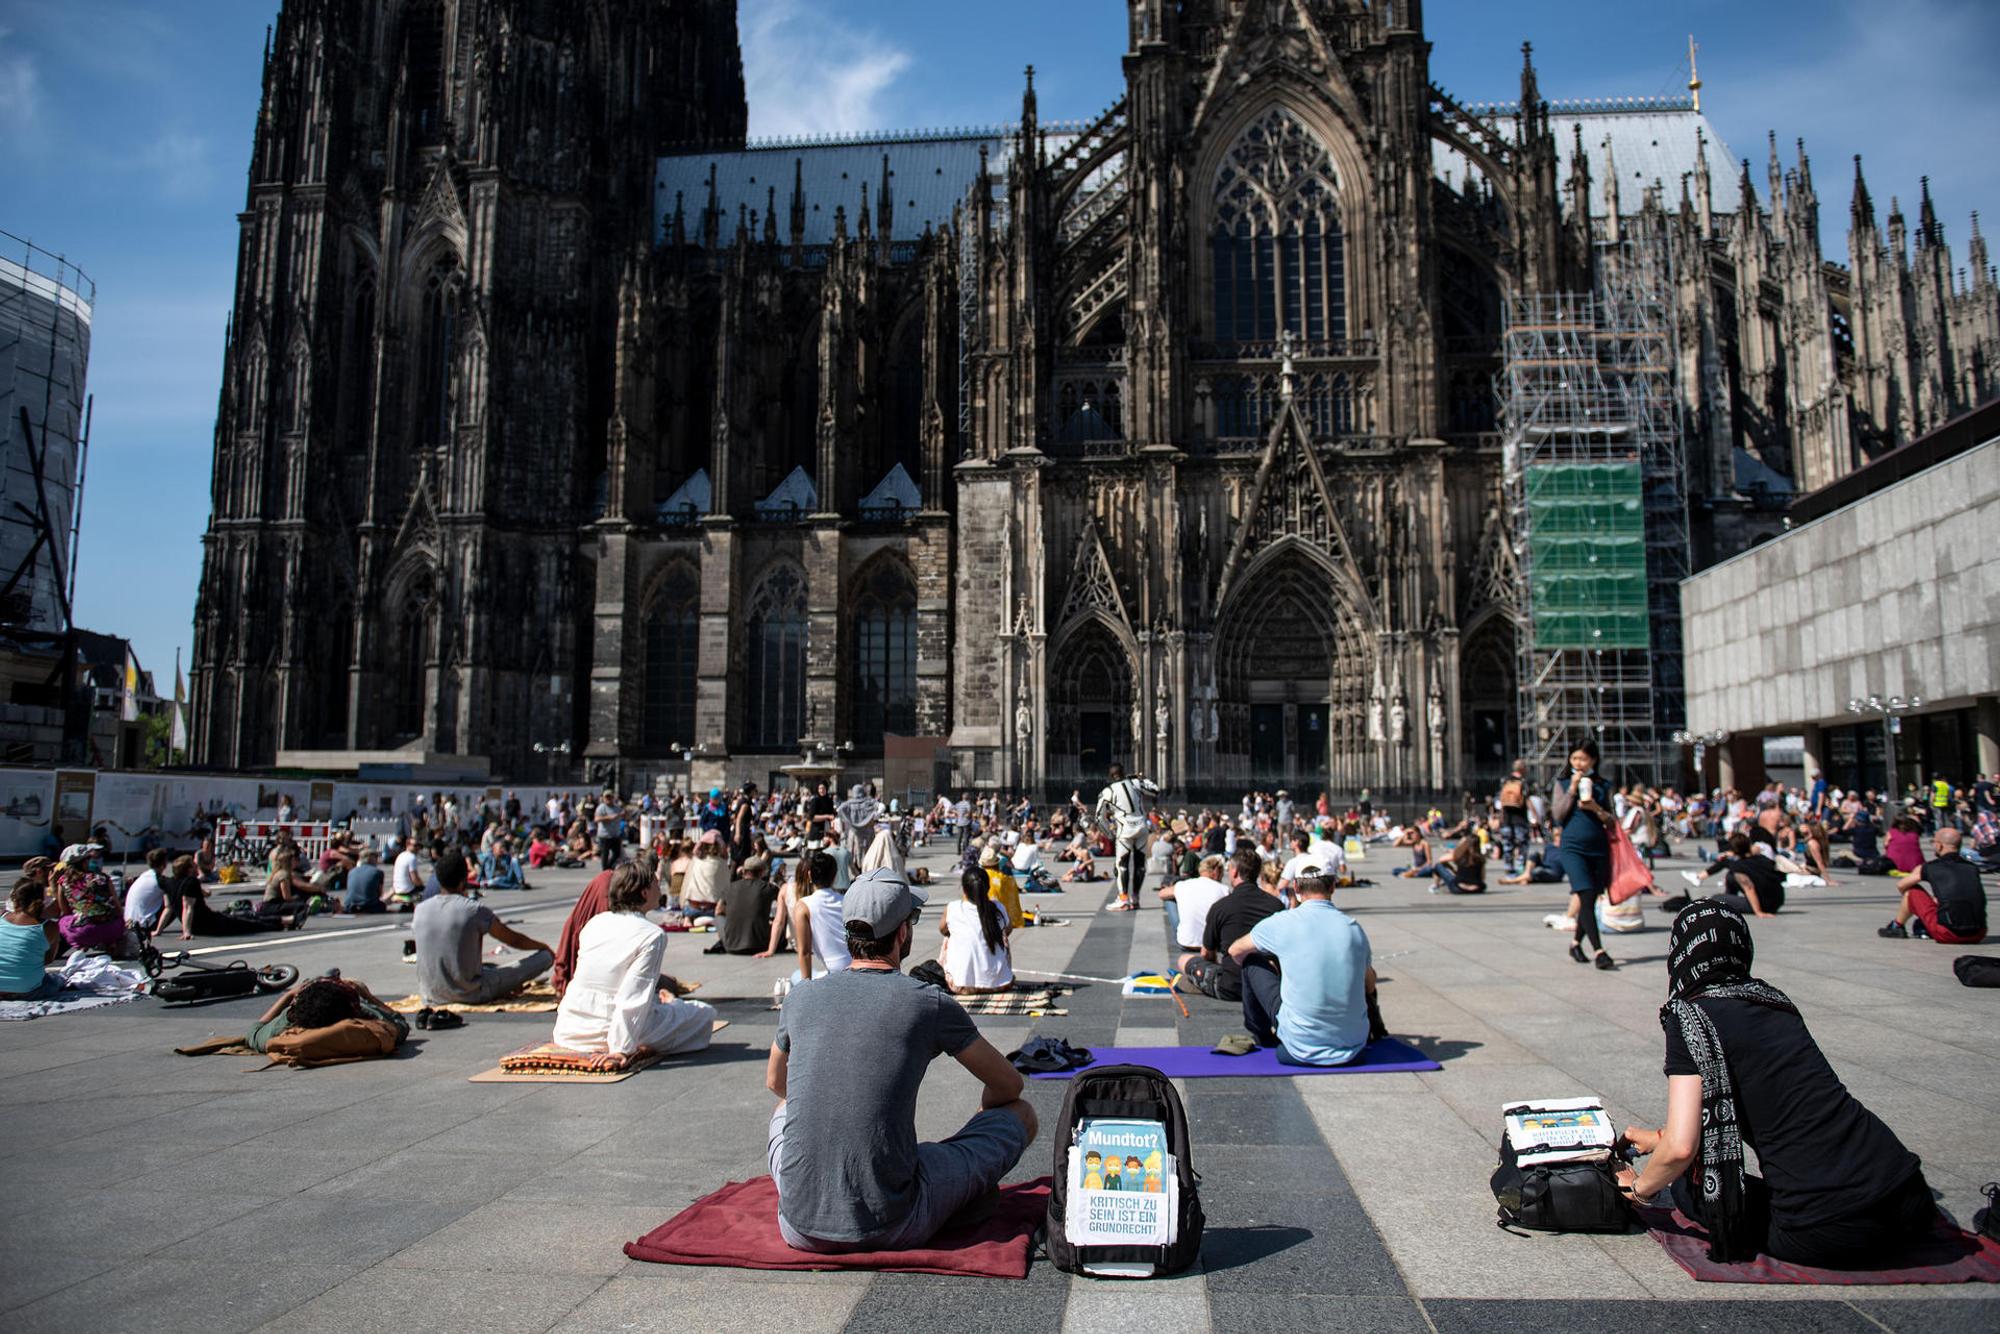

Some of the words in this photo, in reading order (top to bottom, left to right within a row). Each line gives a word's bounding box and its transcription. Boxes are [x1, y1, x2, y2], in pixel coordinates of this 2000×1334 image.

[1089, 1131, 1158, 1148] Mundtot?
[1090, 1196, 1140, 1209] KRITISCH
[1143, 1199, 1157, 1211] ZU
[1089, 1209, 1115, 1221] SEIN
[1118, 1210, 1135, 1222] IST
[1138, 1211, 1157, 1223] EIN
[1089, 1222, 1156, 1235] GRUNDRECHT!
